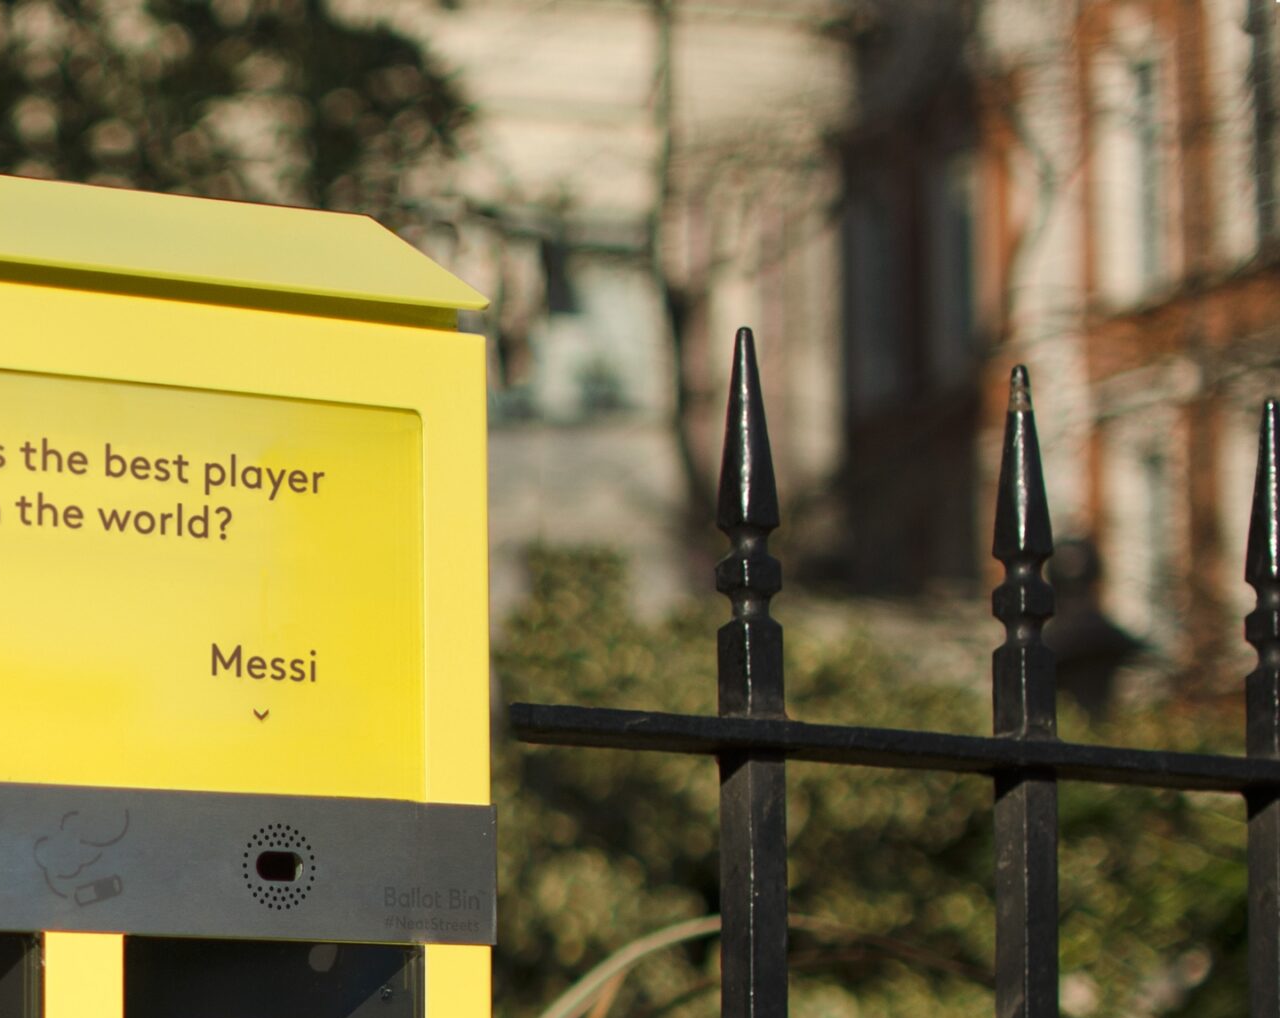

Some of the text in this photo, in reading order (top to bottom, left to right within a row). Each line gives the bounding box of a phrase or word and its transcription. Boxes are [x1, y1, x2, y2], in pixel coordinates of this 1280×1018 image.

[19, 437, 89, 476] the
[104, 442, 190, 485] best
[204, 452, 326, 502] player
[14, 491, 85, 530] the
[97, 502, 234, 541] world?
[211, 642, 317, 683] Messi
[384, 886, 443, 909] Ballot
